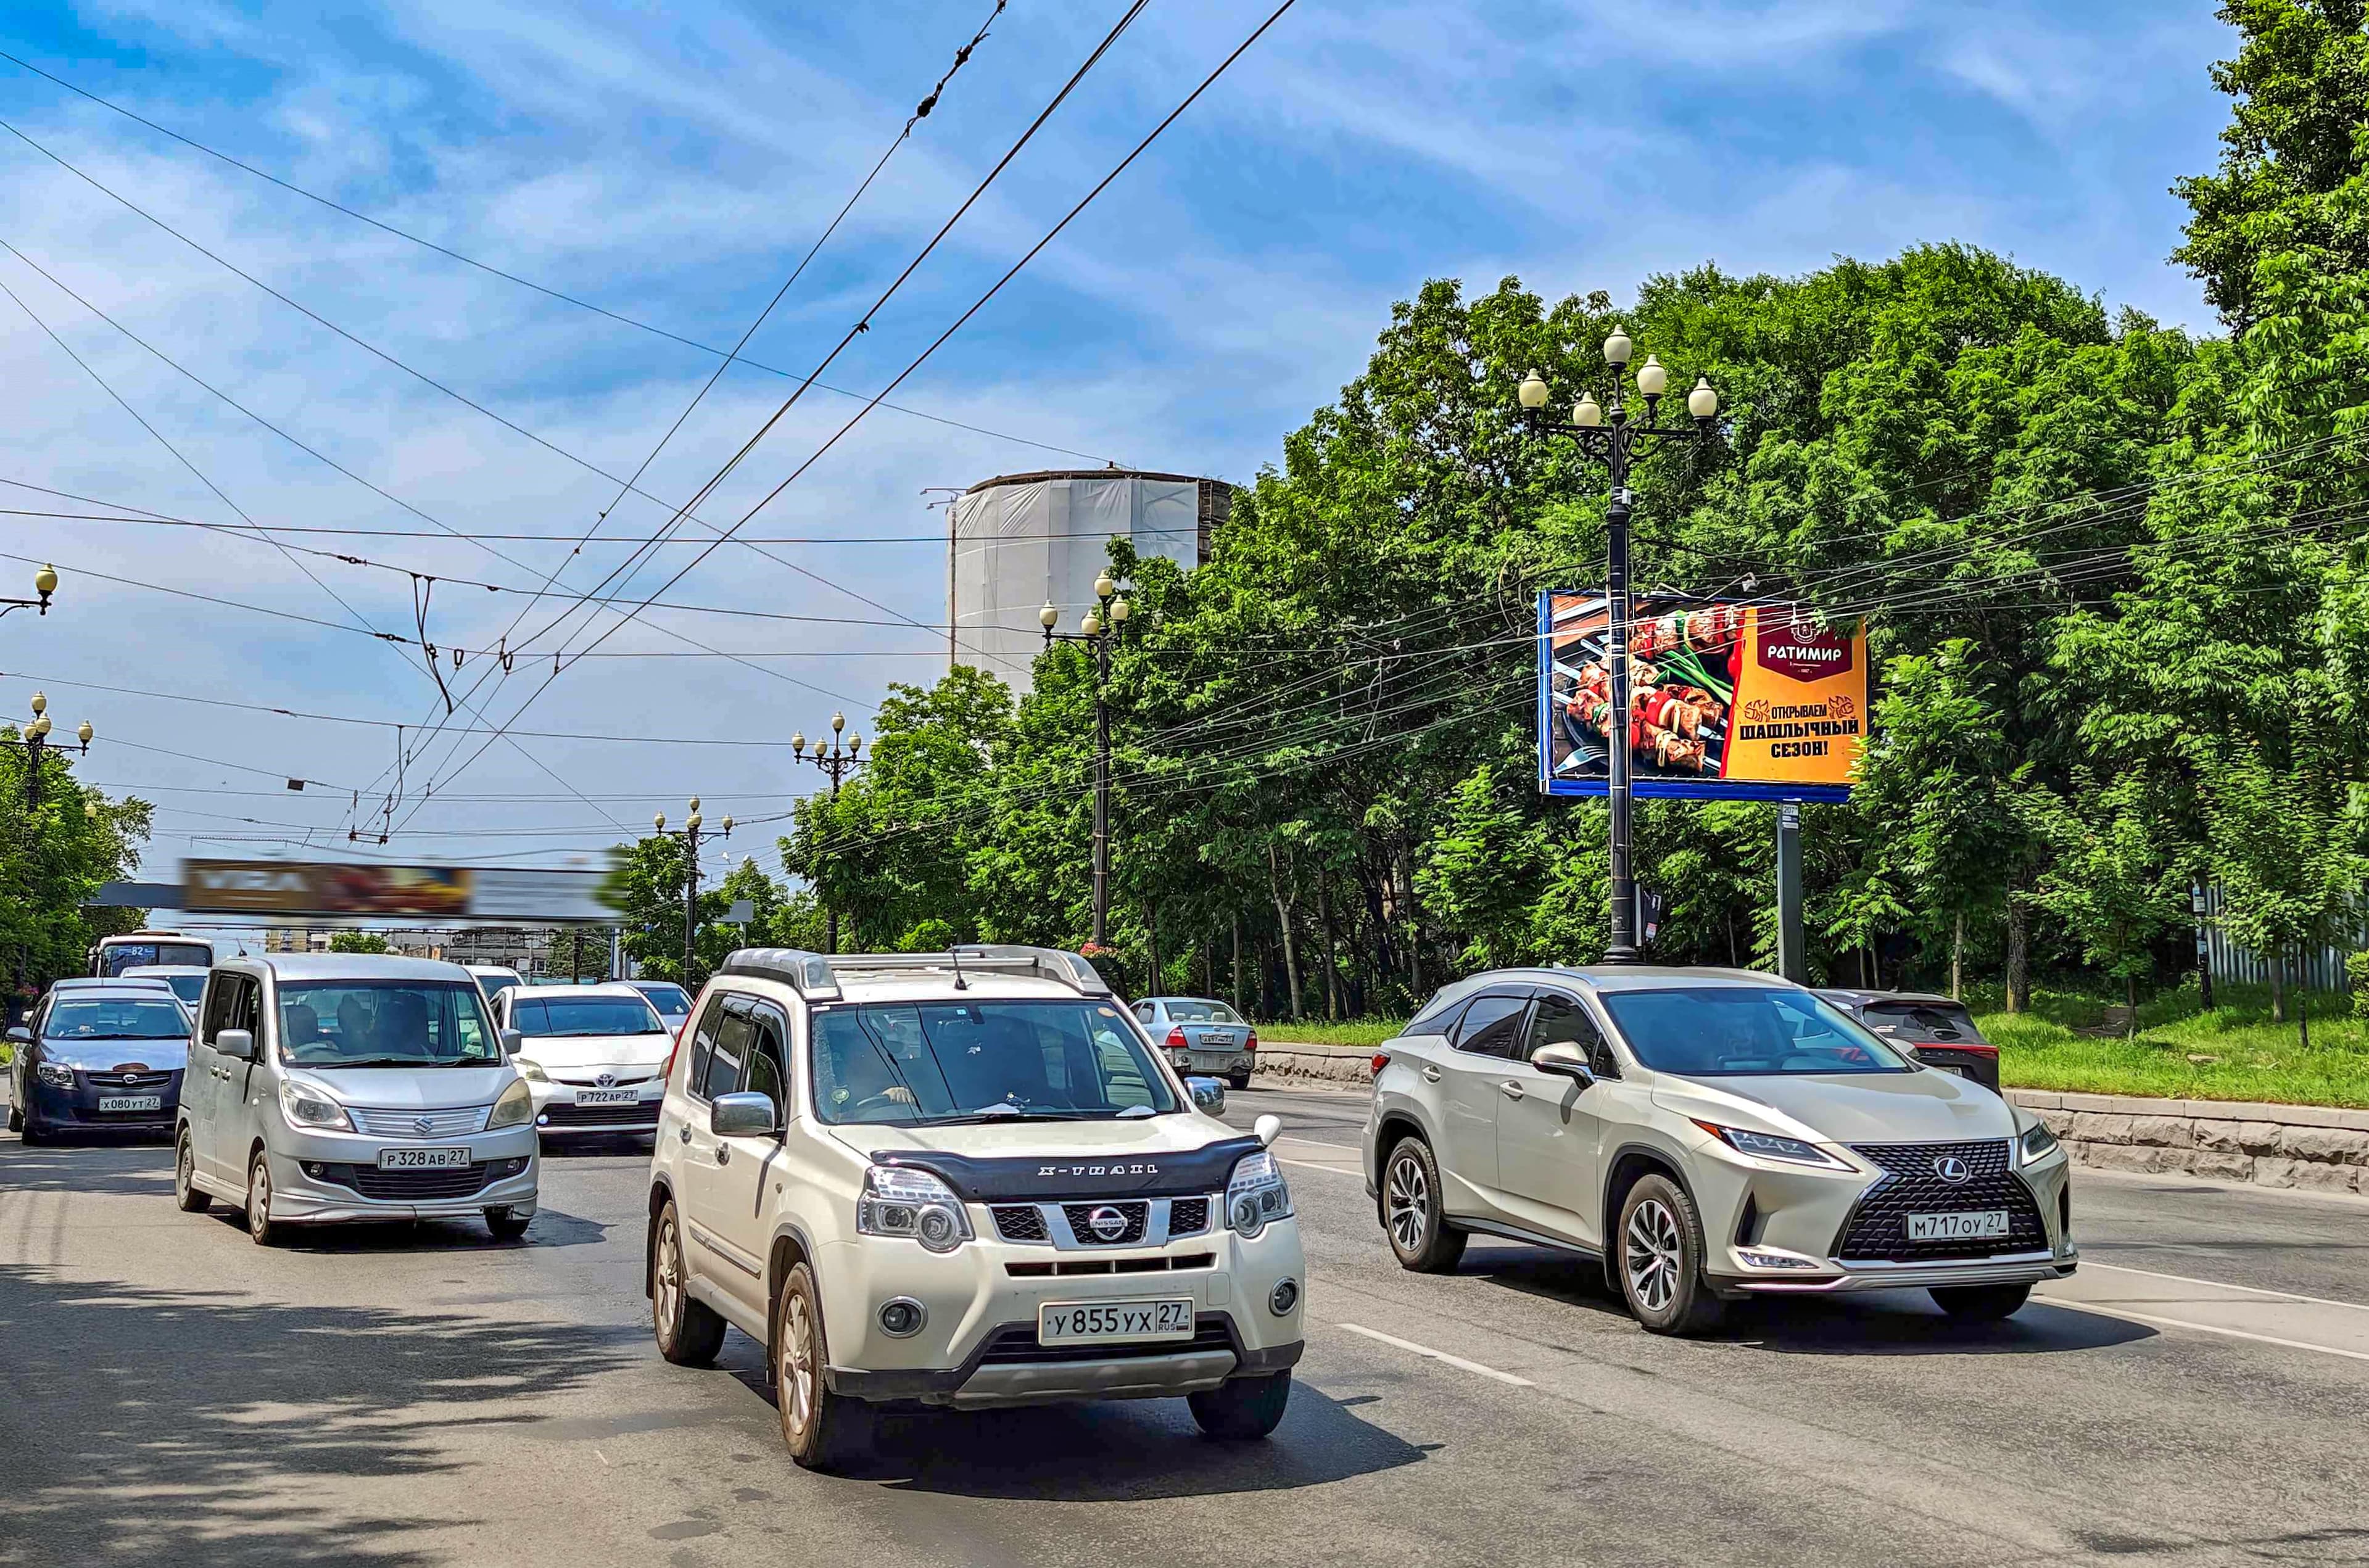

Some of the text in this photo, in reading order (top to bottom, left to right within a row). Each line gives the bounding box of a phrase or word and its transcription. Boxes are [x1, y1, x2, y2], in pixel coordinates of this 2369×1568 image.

[1771, 704, 1827, 719] ОТКРЫВАЕМ
[1740, 716, 1859, 740] ШАШЛЫЧНЫЙ
[1771, 740, 1829, 758] СЕЗОН!
[131, 946, 143, 956] 82
[146, 1098, 157, 1106] 27
[450, 1150, 465, 1161] 27
[1094, 1219, 1125, 1227] NISSAN
[1986, 1213, 2002, 1228] 27
[1159, 1304, 1182, 1323] 27
[1158, 1323, 1175, 1331] RUS
